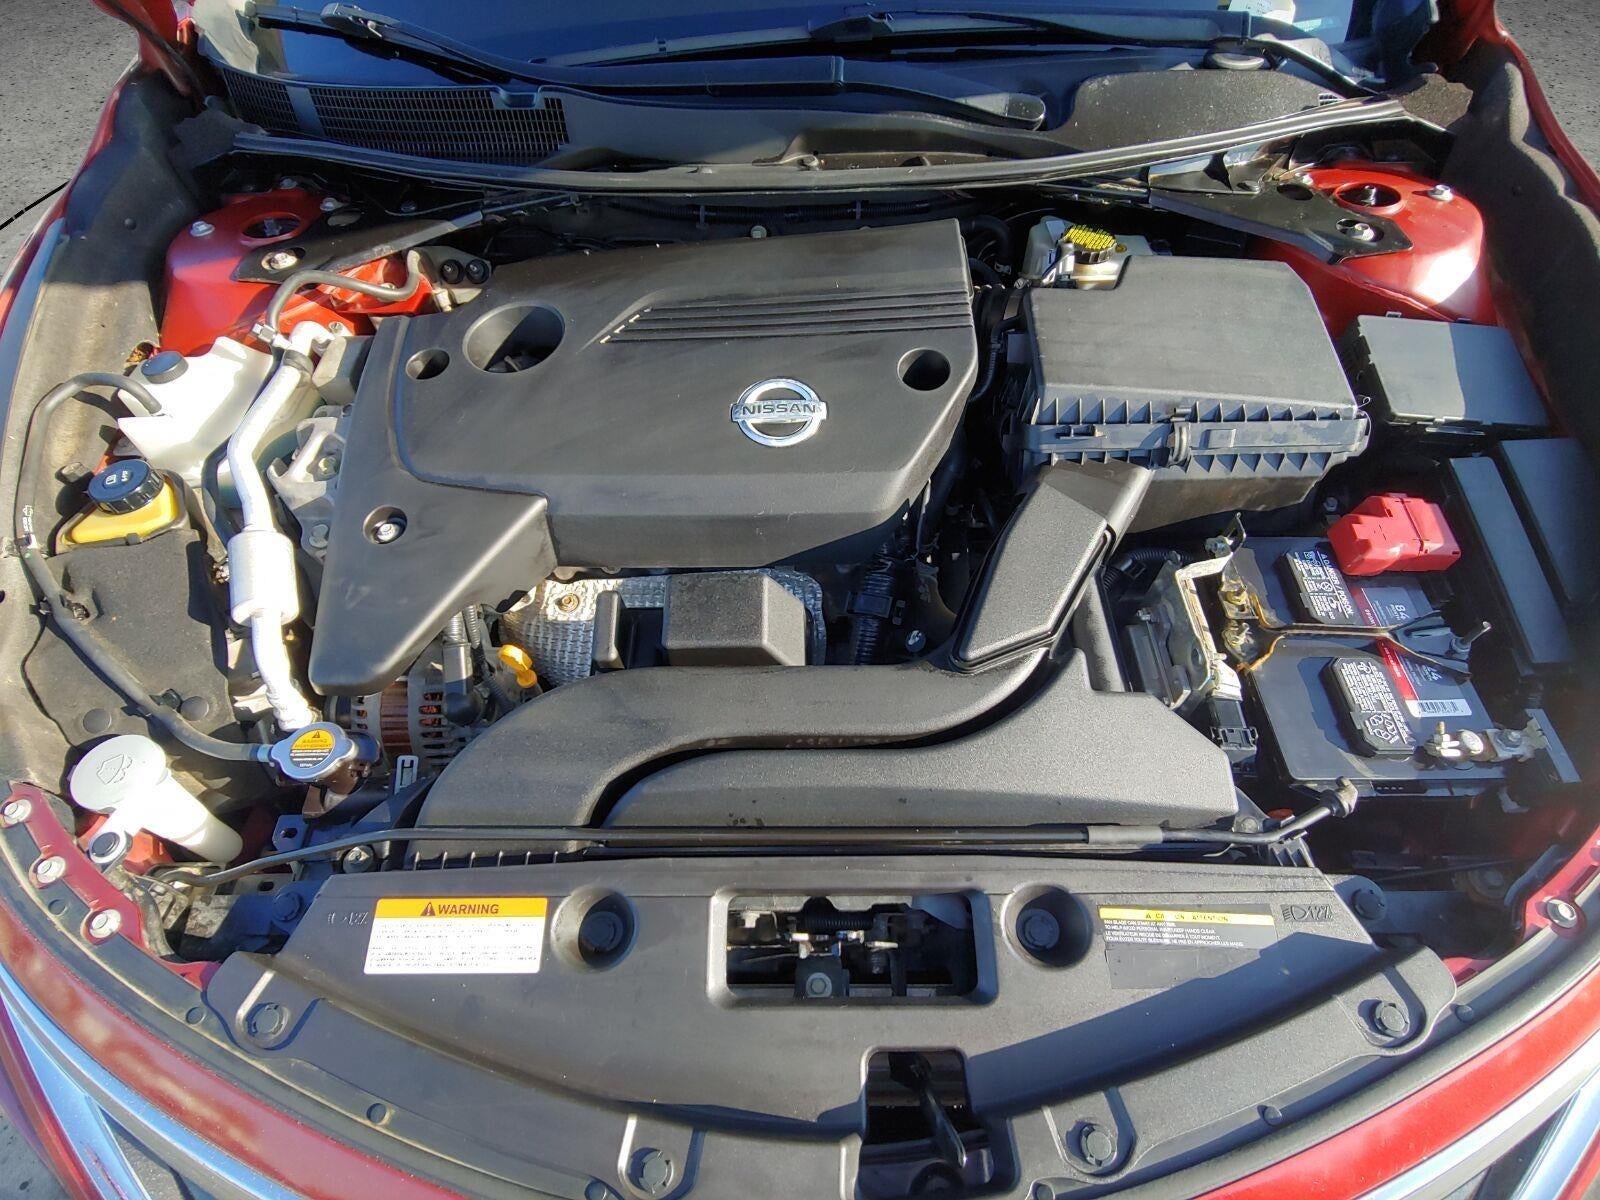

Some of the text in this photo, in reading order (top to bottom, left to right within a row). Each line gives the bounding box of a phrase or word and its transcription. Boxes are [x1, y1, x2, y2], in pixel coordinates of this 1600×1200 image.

[742, 403, 816, 415] NISSAN
[1337, 590, 1354, 615] POISON
[438, 903, 500, 915] WARNING
